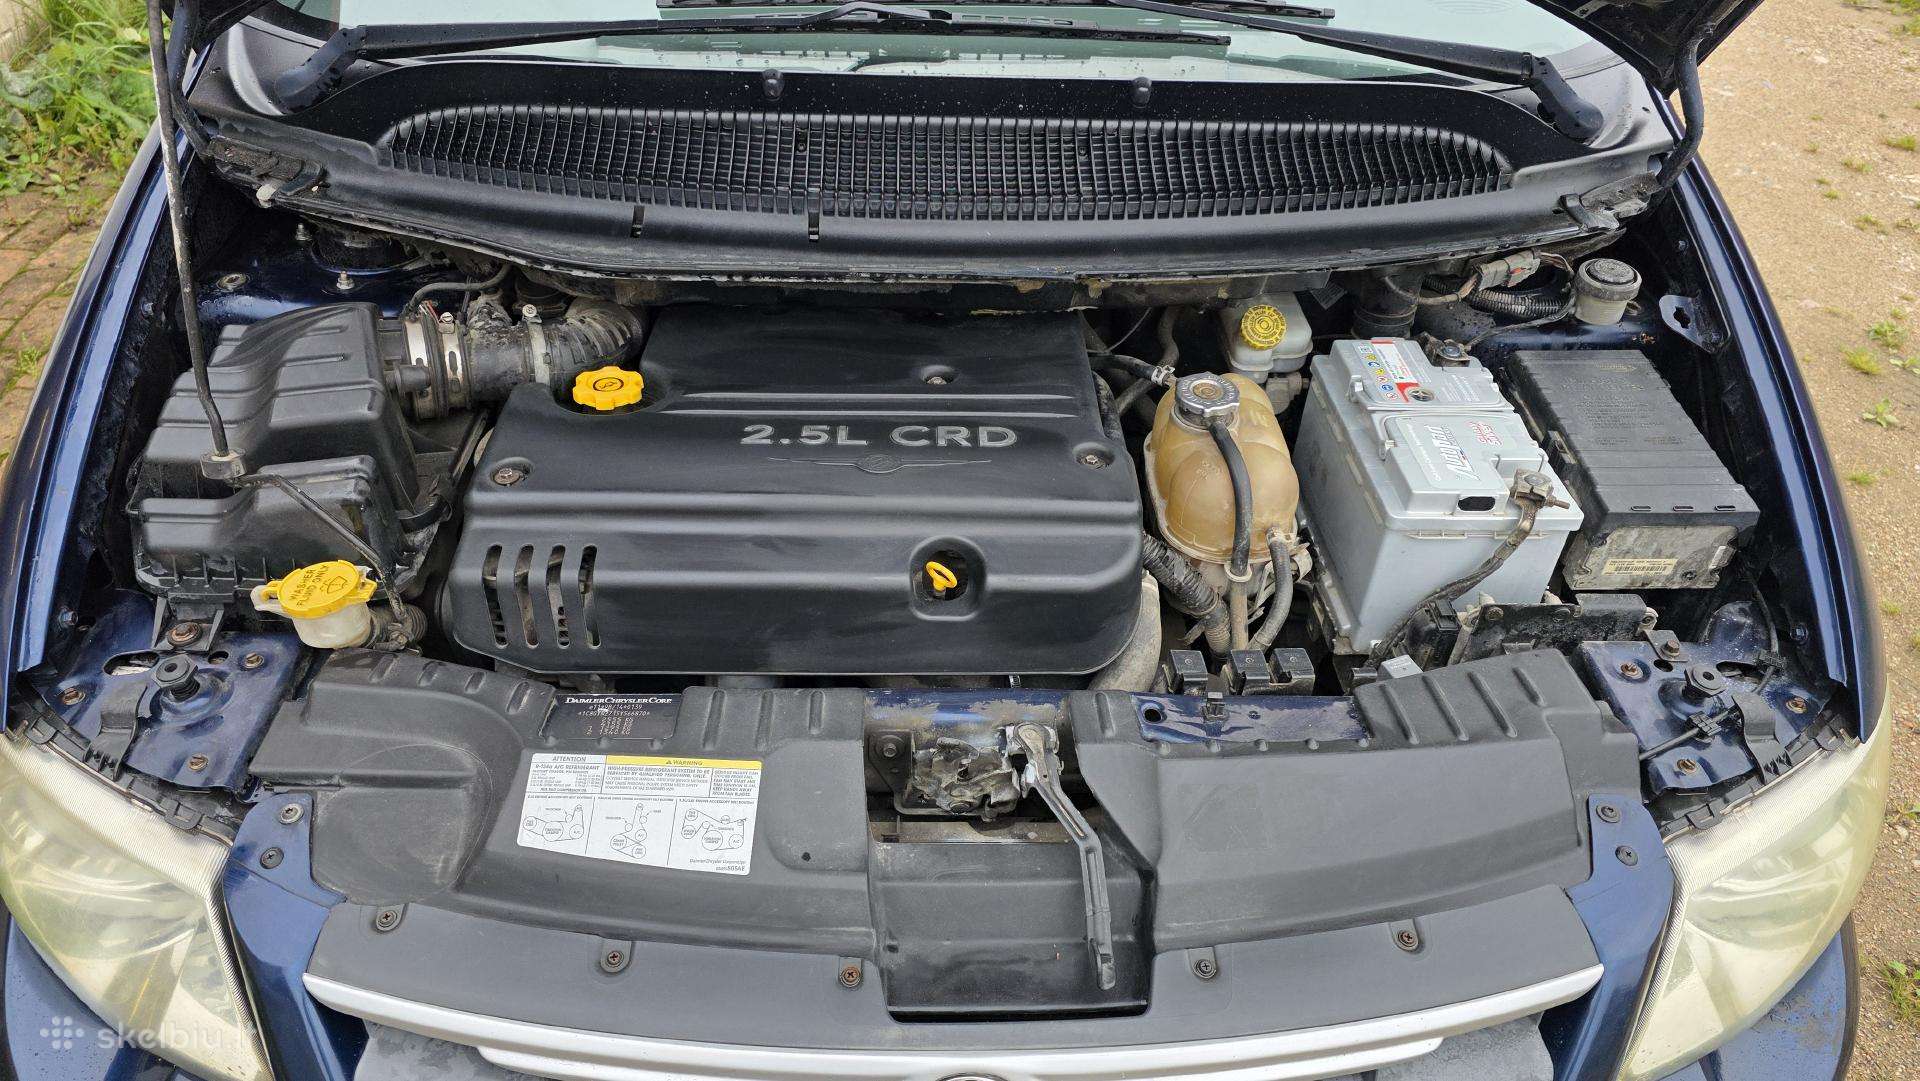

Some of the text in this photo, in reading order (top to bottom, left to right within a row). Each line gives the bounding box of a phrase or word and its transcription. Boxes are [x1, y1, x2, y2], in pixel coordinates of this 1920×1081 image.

[740, 424, 1018, 447] 2.5L CRD
[290, 568, 316, 600] WASHER
